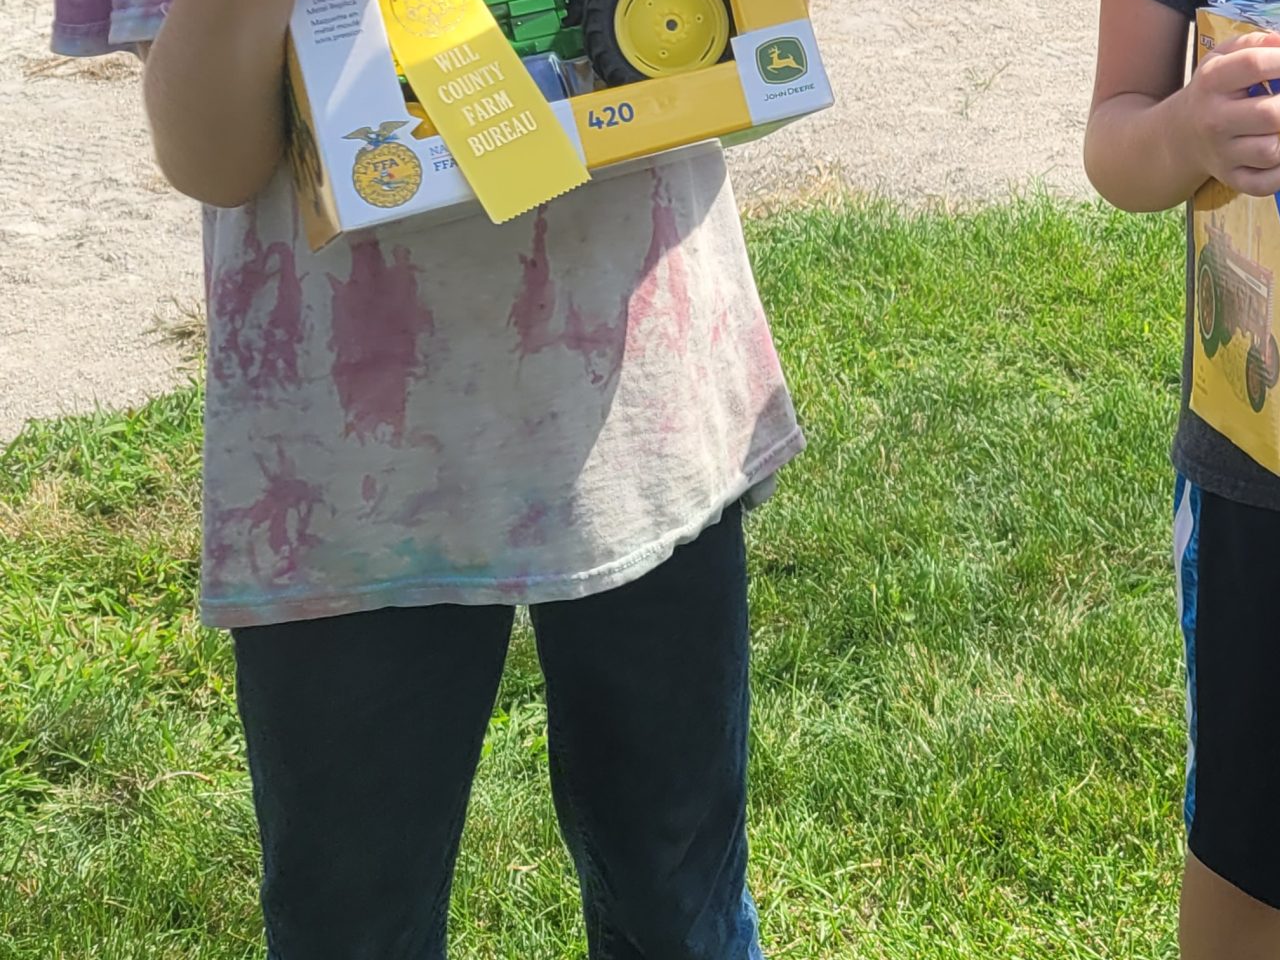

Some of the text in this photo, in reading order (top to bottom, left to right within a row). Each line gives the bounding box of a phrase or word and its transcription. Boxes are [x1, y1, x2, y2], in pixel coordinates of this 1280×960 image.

[434, 43, 480, 74] WILL
[438, 61, 505, 104] COUNTY
[764, 83, 815, 102] JOHN DEERE
[462, 90, 514, 127] FARM
[588, 102, 634, 129] 420
[467, 111, 538, 157] BUREAU
[373, 159, 399, 172] FFA
